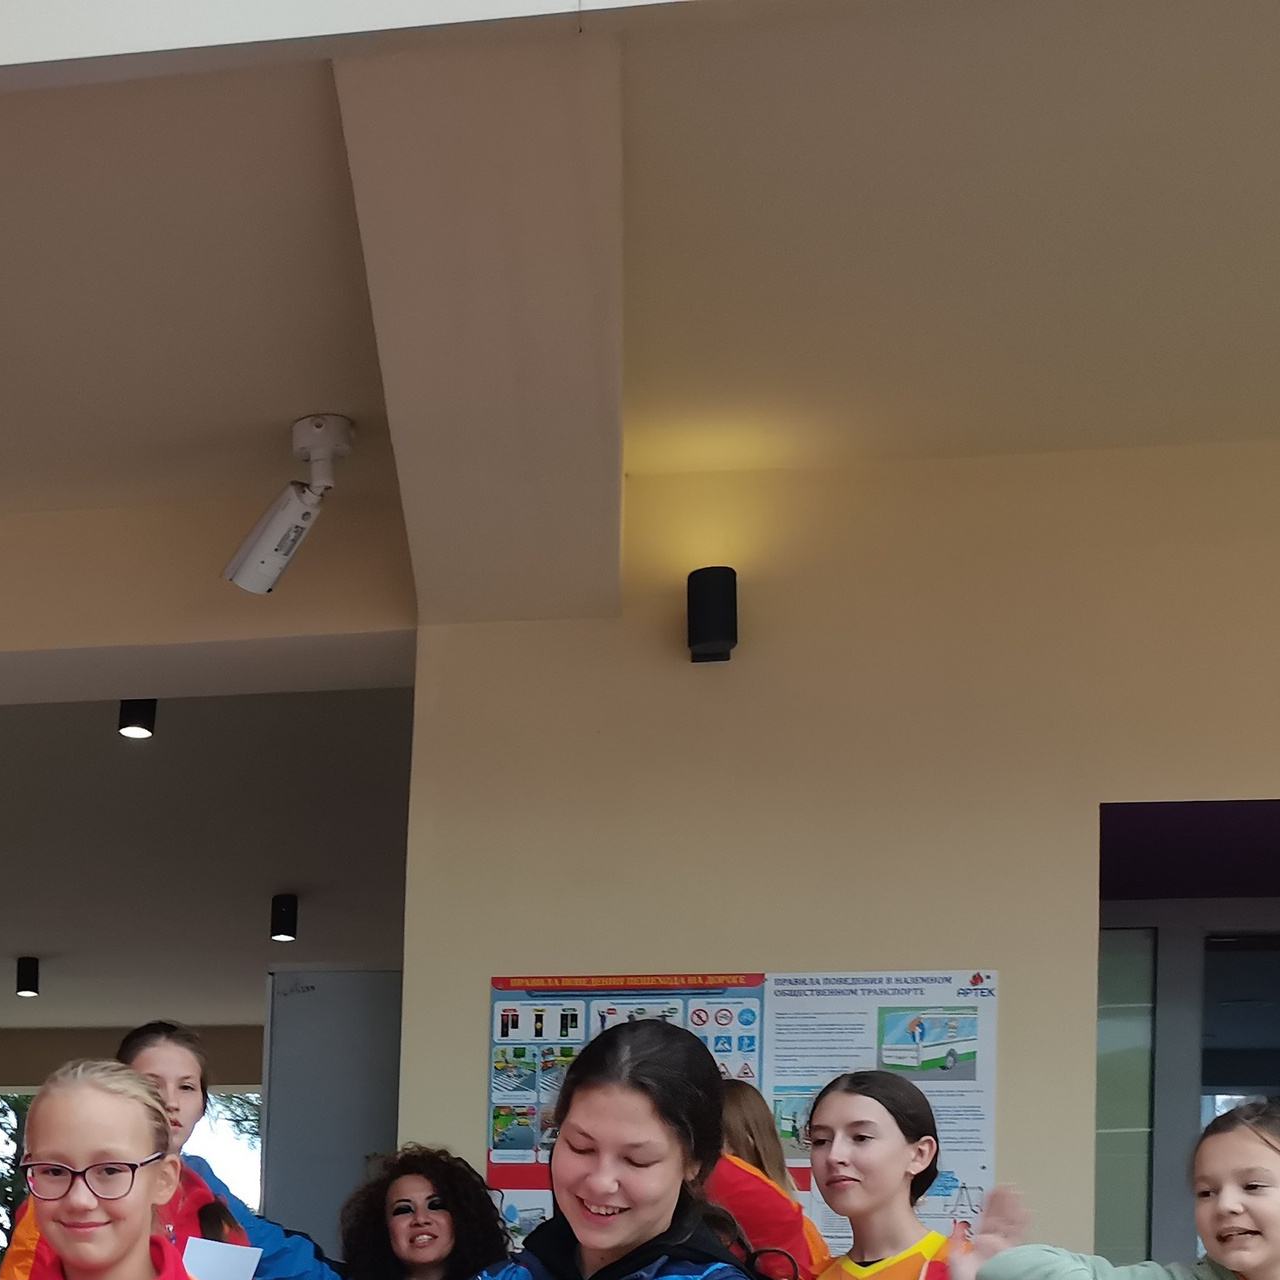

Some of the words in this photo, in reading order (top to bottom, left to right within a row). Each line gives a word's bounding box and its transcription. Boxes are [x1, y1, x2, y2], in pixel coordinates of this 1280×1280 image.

[687, 975, 703, 984] НА
[774, 977, 821, 986] ПРАВИЛА
[822, 977, 884, 985] ПОВЕДЕНИЯ
[895, 976, 952, 984] НАЗЕМНОМ
[774, 988, 858, 997] ОБЩЕСТВЕННОМ
[860, 987, 926, 996] ТРАНСПОРТЕ
[956, 987, 996, 997] АРТЕК
